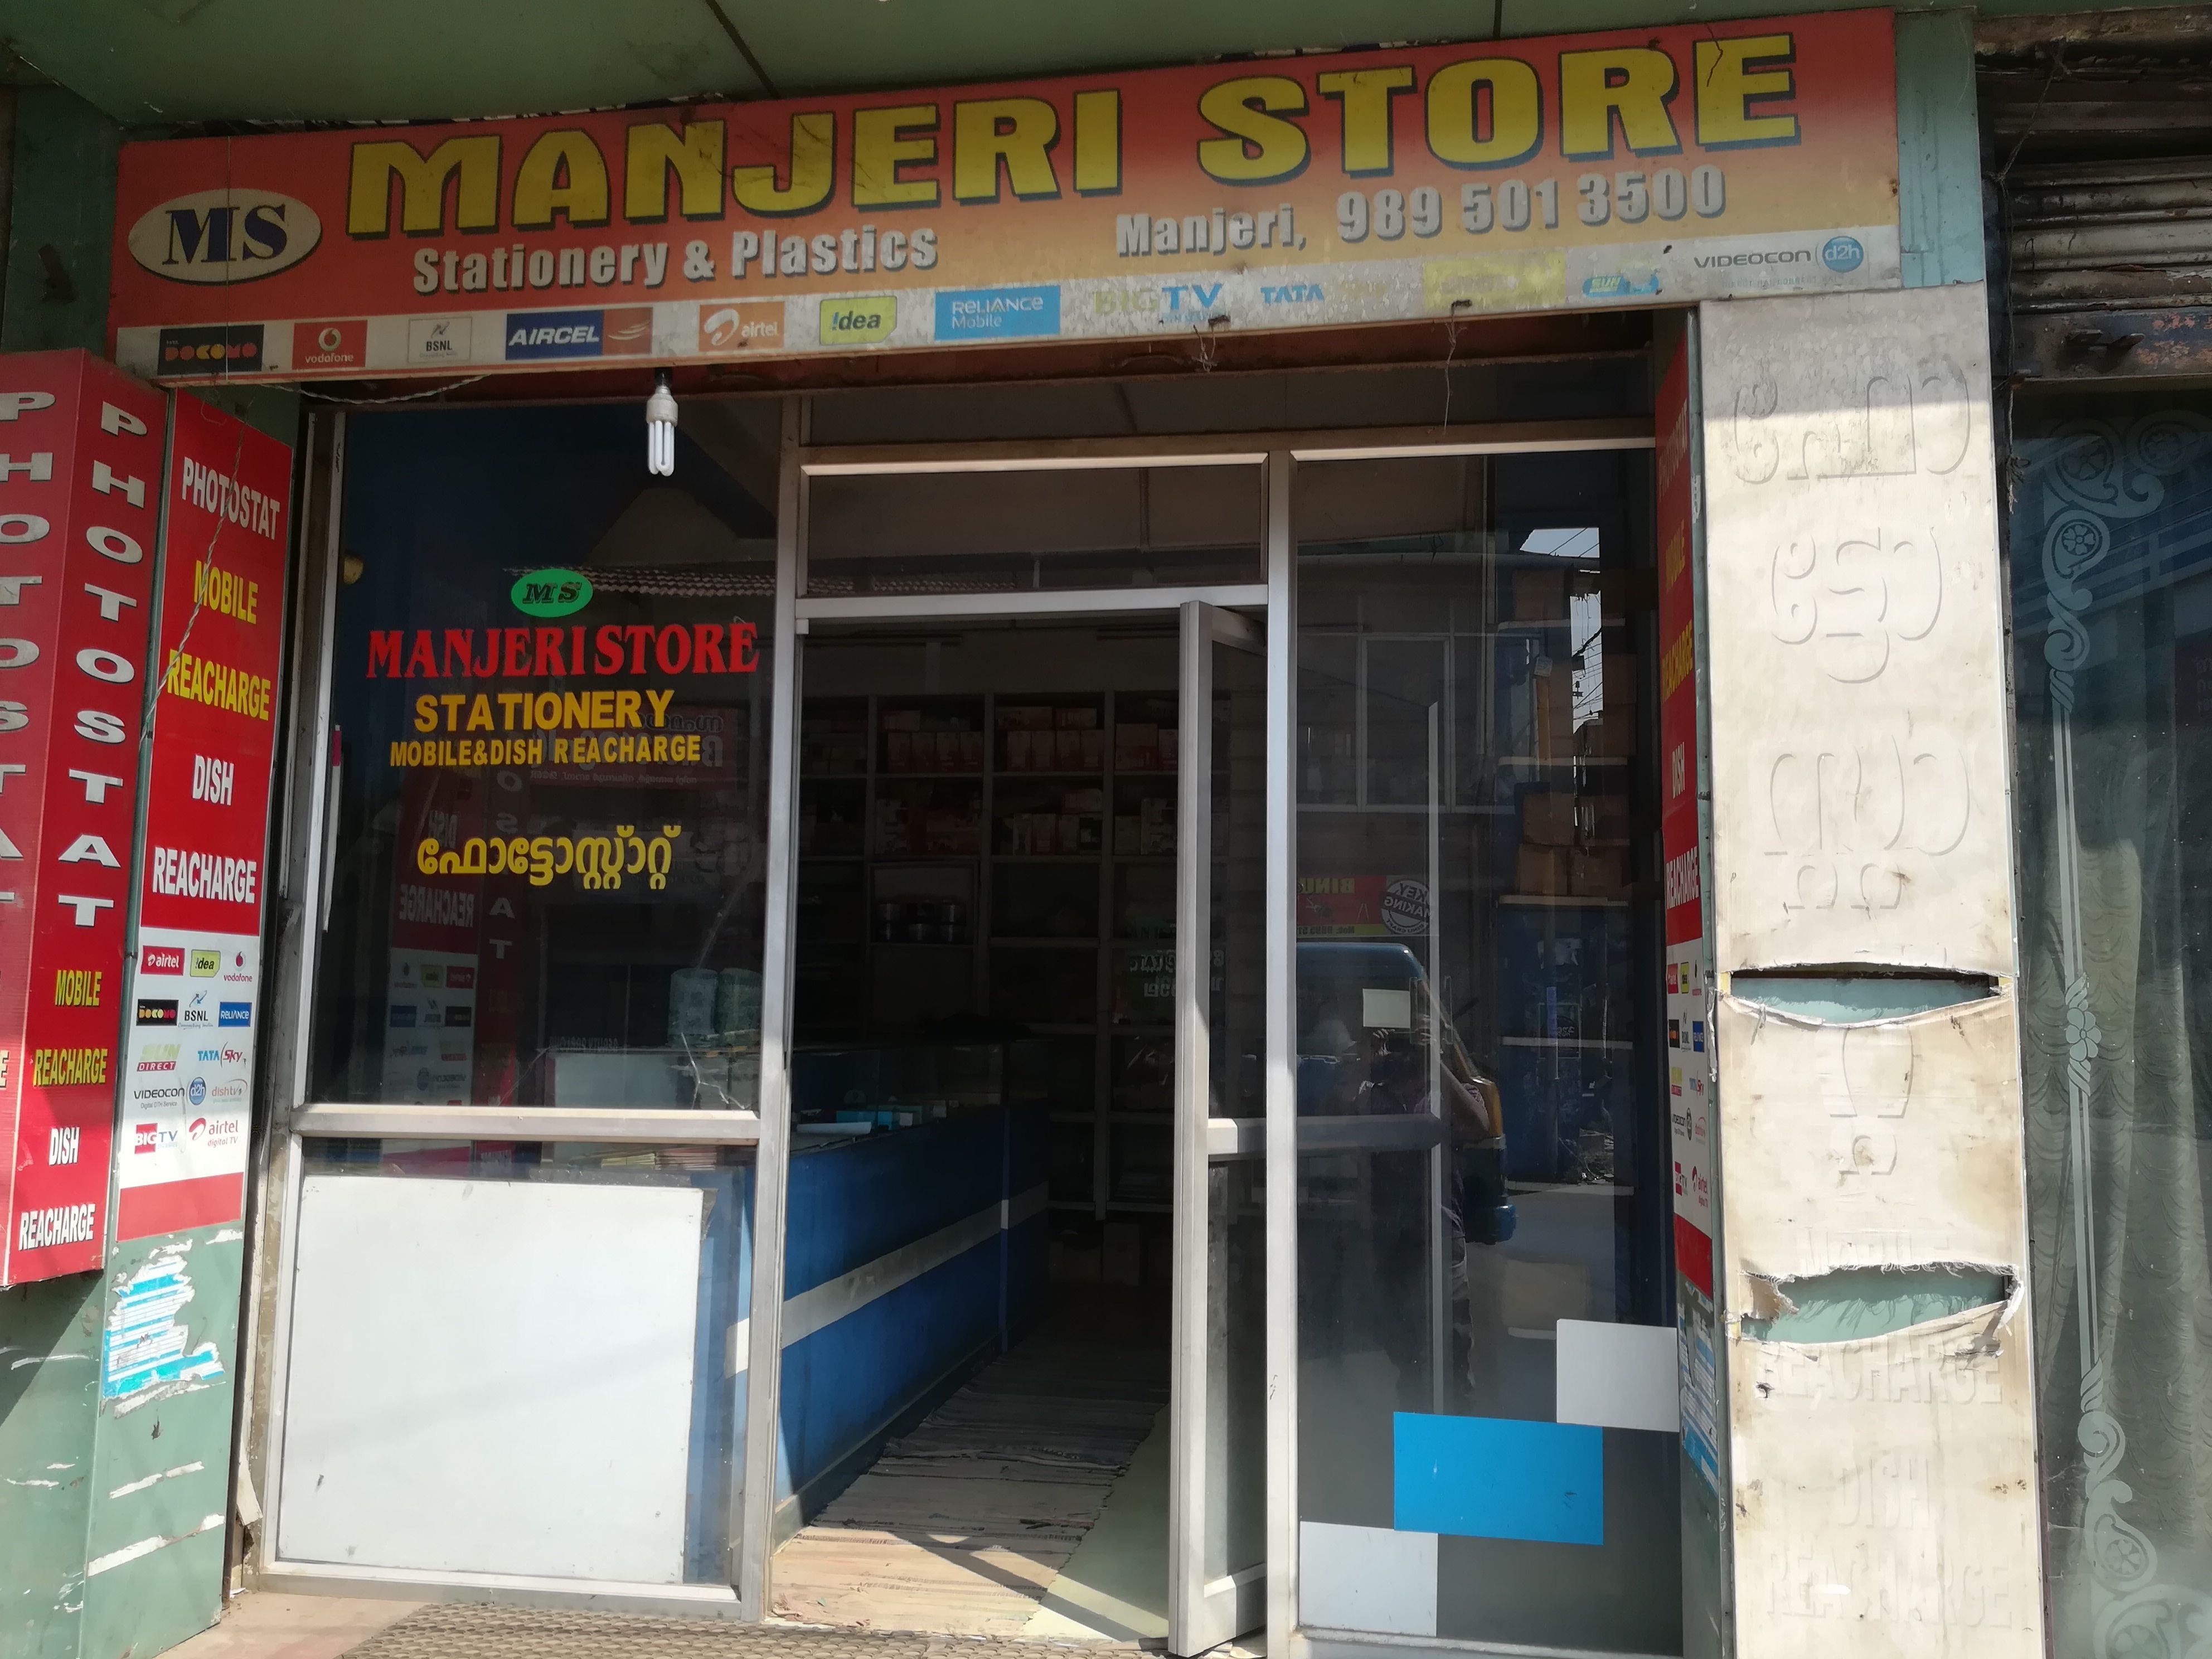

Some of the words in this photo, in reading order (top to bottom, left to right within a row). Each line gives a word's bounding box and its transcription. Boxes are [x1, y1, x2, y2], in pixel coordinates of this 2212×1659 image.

[346, 89, 1122, 239] MANJERI
[1196, 32, 1801, 187] STORE
[1117, 203, 1307, 257] Manjeri,
[1337, 186, 1443, 243] 989
[1462, 178, 1559, 235] 501
[1578, 164, 1726, 226] 3500
[162, 203, 288, 266] MS
[413, 241, 669, 296] Stationery
[684, 239, 716, 282] &
[732, 225, 939, 279] Plastics
[1694, 250, 1811, 269] VIDEOCON
[1825, 244, 1860, 261] d2h
[1260, 284, 1325, 304] TATA
[508, 326, 600, 346] AIRCEL
[741, 319, 778, 338] airtel
[952, 314, 1002, 329] Mobile
[305, 352, 354, 365] vodafone
[426, 339, 453, 352] BSNL
[182, 457, 280, 540] PHOTOSTAT
[193, 560, 258, 624] MOBILE
[58, 401, 148, 928] PHOTOSTAT
[366, 624, 586, 679] MANJERI
[594, 622, 759, 676] STORE
[167, 649, 271, 721] REACHARGE
[414, 689, 675, 733] STATIONERY
[390, 739, 543, 767] MOBILE&DISH
[554, 735, 701, 764] REACHARGE
[192, 754, 235, 807] DISH
[152, 847, 257, 904] REACHARGE
[1666, 846, 1699, 910] REACHARGE
[156, 953, 179, 968] airtel
[224, 973, 253, 982] vodafone
[55, 969, 103, 1007] MOBILE
[185, 1010, 208, 1022] BSNL
[33, 1048, 108, 1086] REACHARGE
[139, 1061, 174, 1071] DIRECT
[198, 1050, 220, 1061] TATA
[223, 1050, 243, 1063] Sky
[134, 1088, 185, 1099] VIDEOCON
[190, 1084, 205, 1097] d2h
[48, 1127, 80, 1166] DISH
[207, 1138, 228, 1148] digital
[230, 1136, 238, 1144] TV
[208, 1120, 239, 1136] airtel
[18, 1204, 96, 1251] REACHARGE
